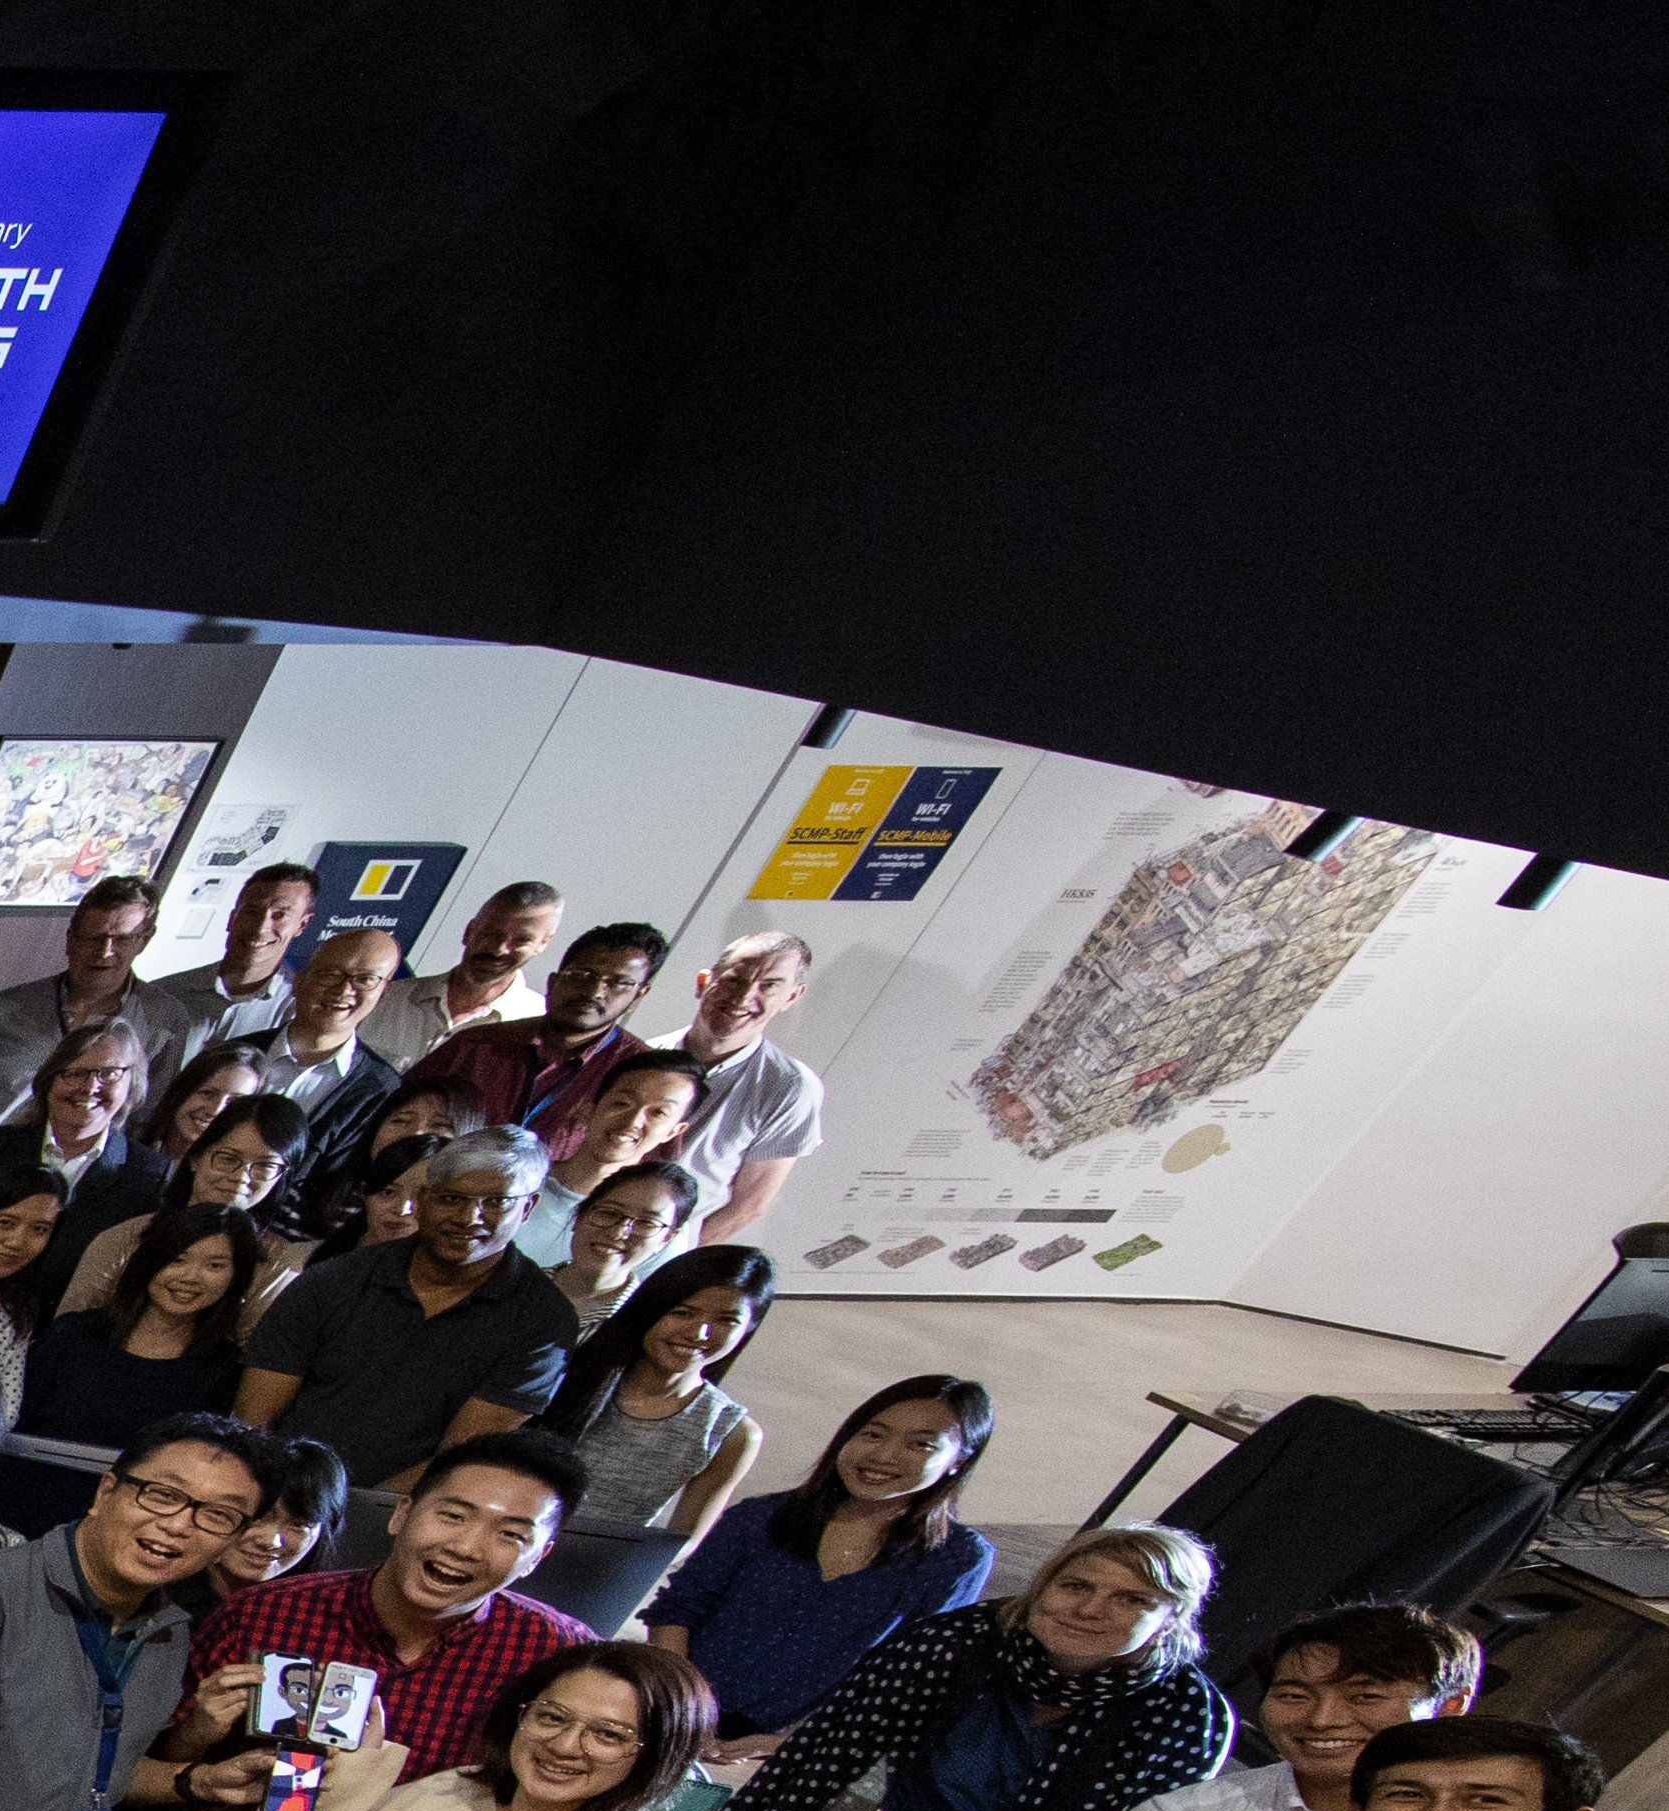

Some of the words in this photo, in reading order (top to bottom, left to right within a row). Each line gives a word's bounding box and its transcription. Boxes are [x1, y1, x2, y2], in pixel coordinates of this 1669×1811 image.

[790, 827, 868, 840] SCMP-Staff
[877, 829, 953, 841] SCMP-Mobile
[327, 915, 364, 927] South
[363, 915, 398, 927] China
